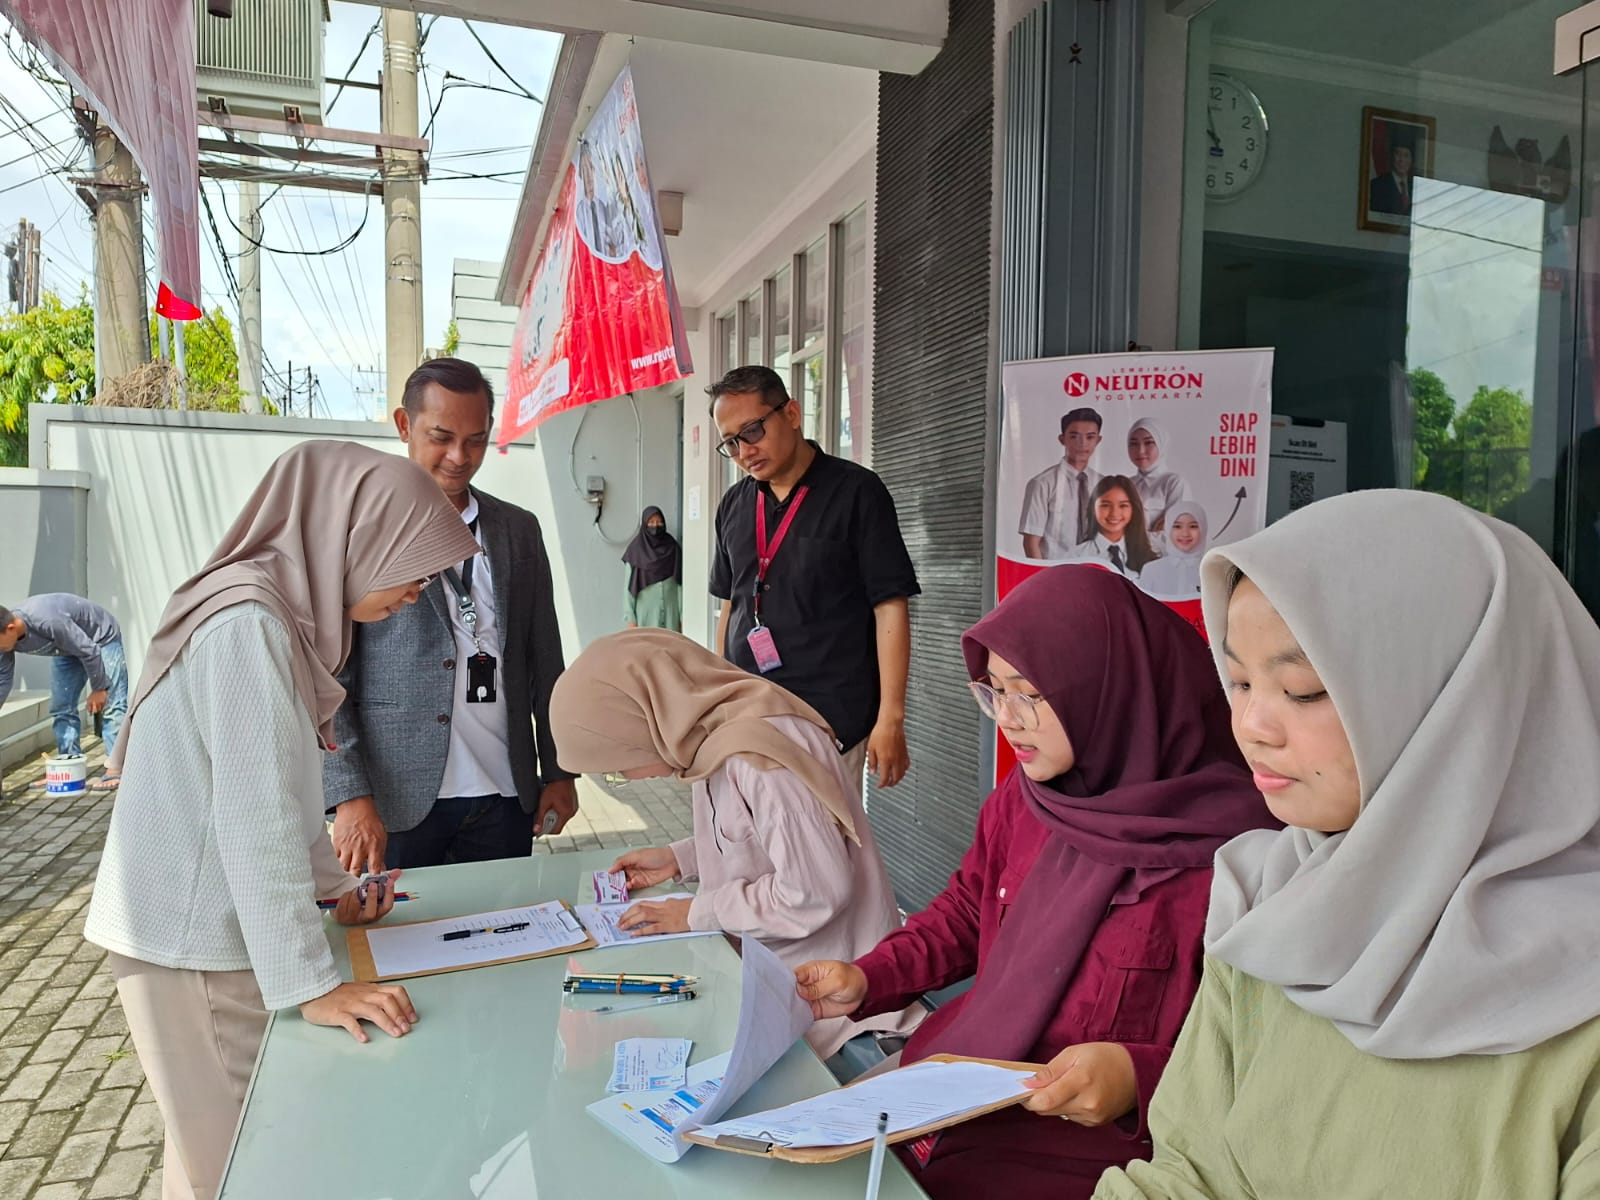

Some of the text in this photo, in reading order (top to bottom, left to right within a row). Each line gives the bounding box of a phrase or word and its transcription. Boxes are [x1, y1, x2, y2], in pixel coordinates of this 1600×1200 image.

[1209, 87, 1223, 101] 12
[1231, 97, 1237, 110] 1
[1241, 115, 1252, 130] 2
[1246, 137, 1256, 152] 3
[1239, 158, 1249, 171] 4
[1206, 174, 1216, 188] 6
[1224, 172, 1235, 186] 5
[1095, 372, 1203, 392] NEUTRON
[1095, 392, 1203, 401] YOGYAKARTA
[1219, 412, 1258, 433] SIAP
[1210, 435, 1257, 455] LEBIH
[1220, 457, 1256, 477] DINI
